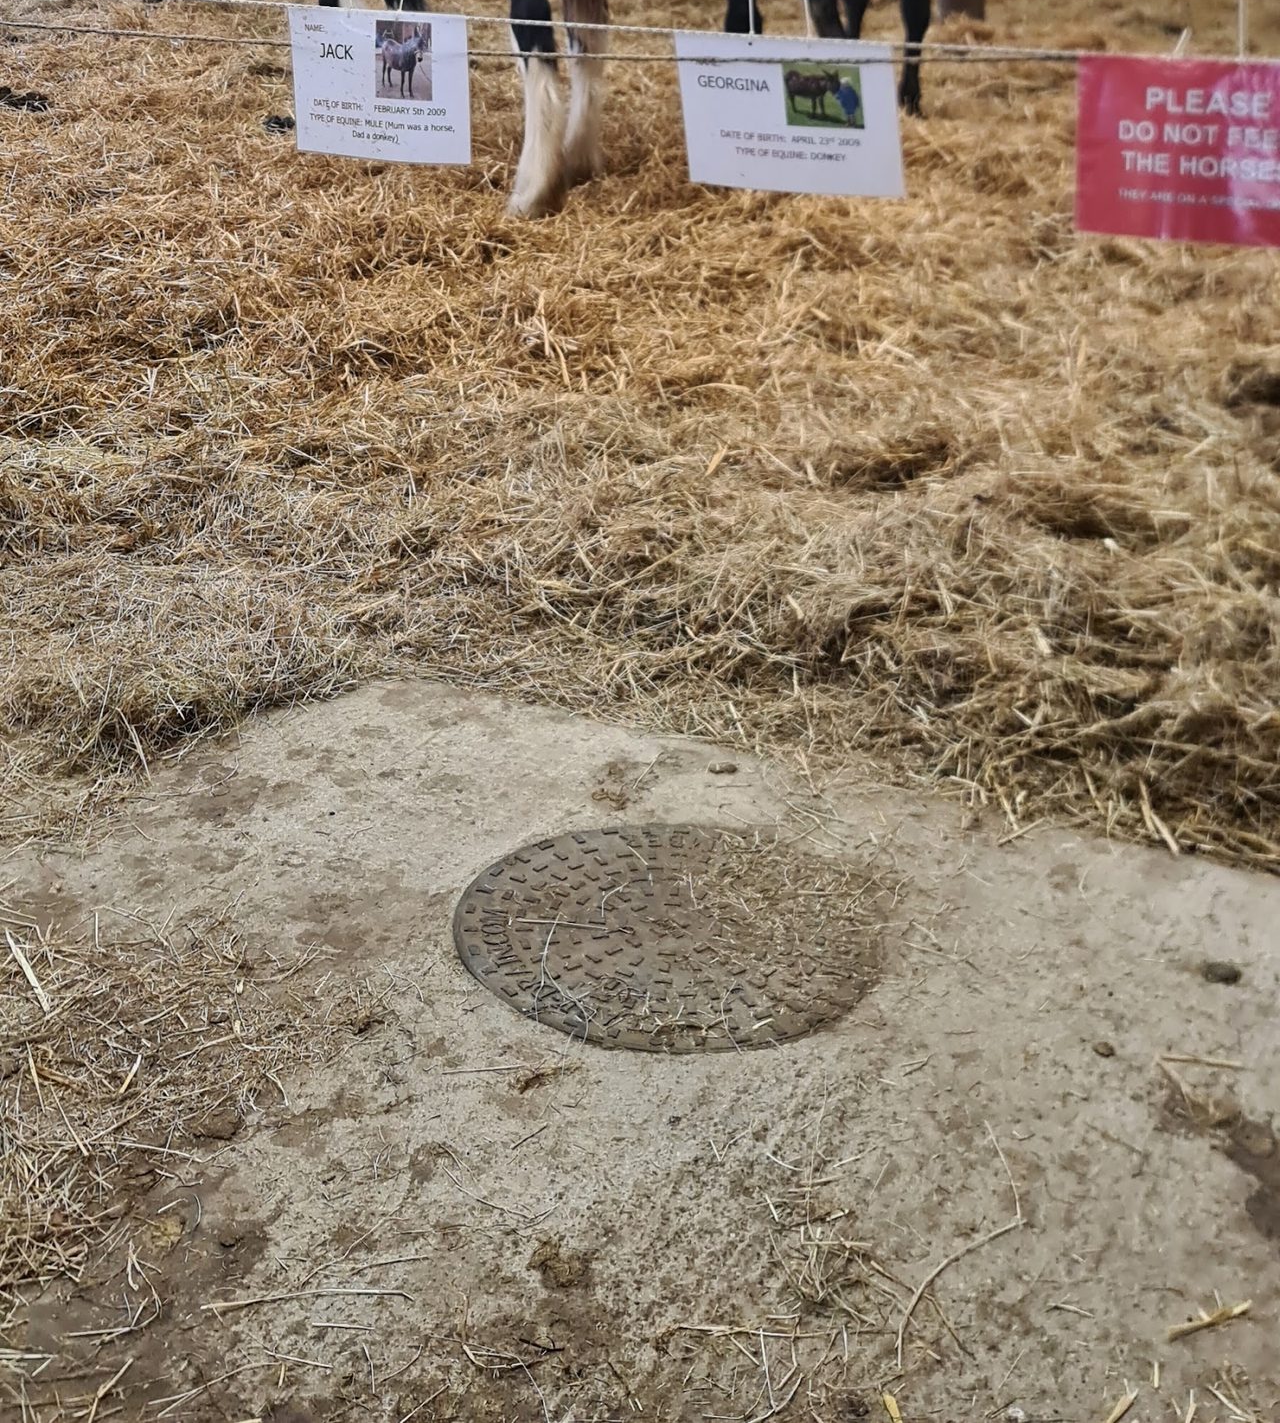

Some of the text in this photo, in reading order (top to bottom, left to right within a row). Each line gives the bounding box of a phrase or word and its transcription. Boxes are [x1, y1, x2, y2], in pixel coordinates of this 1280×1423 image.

[319, 42, 354, 61] JACK
[697, 75, 770, 93] GEORGINA
[313, 98, 330, 109] DATE
[330, 100, 340, 109] OF
[373, 104, 410, 115] FEBRUARY
[412, 107, 425, 116] 5th
[427, 108, 447, 117] 2009
[1145, 86, 1271, 120] PLEASE
[309, 112, 325, 123] TYPE
[326, 114, 335, 123] OF
[336, 116, 363, 127] EQUINE:
[364, 119, 384, 129] MULE
[384, 121, 405, 131] (Mum
[407, 123, 422, 131] was
[430, 124, 455, 134] horse,
[352, 129, 365, 139] Dad
[720, 129, 742, 140] DATE
[743, 132, 755, 140] OF
[791, 135, 816, 145] APRIL
[837, 138, 861, 147] 2009
[1118, 120, 1280, 151] DO NOT FEE
[735, 146, 846, 162] TYPE OF EQUINE: DONKEY
[1121, 150, 1280, 181] THE HORSE
[1176, 192, 1196, 204] ON
[1198, 194, 1207, 205] A
